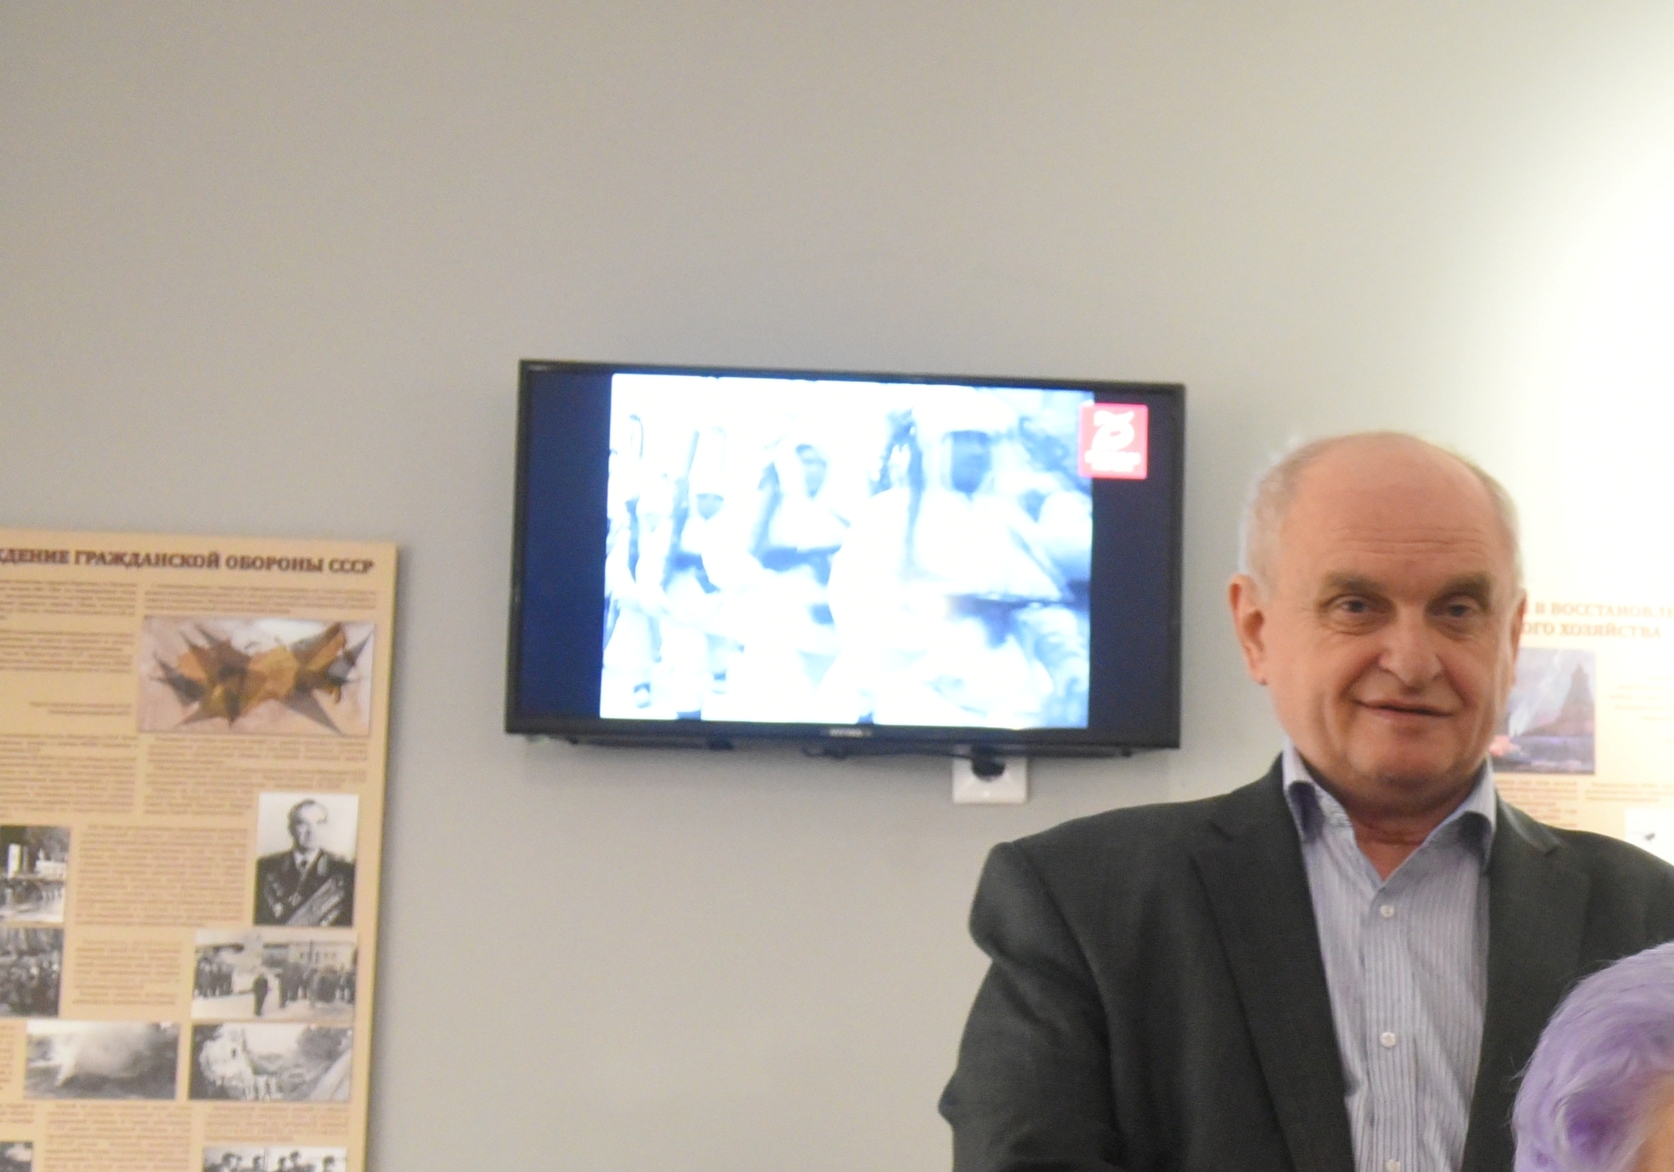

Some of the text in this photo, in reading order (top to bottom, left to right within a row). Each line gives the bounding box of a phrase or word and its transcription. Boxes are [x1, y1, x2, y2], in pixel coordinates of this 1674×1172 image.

[75, 550, 220, 569] ГРАЖДАНСКОЙ
[225, 555, 323, 572] ОБОРОНЫ
[328, 558, 374, 573] СССР
[1559, 621, 1662, 639] ХОЗЯЙСТВА
